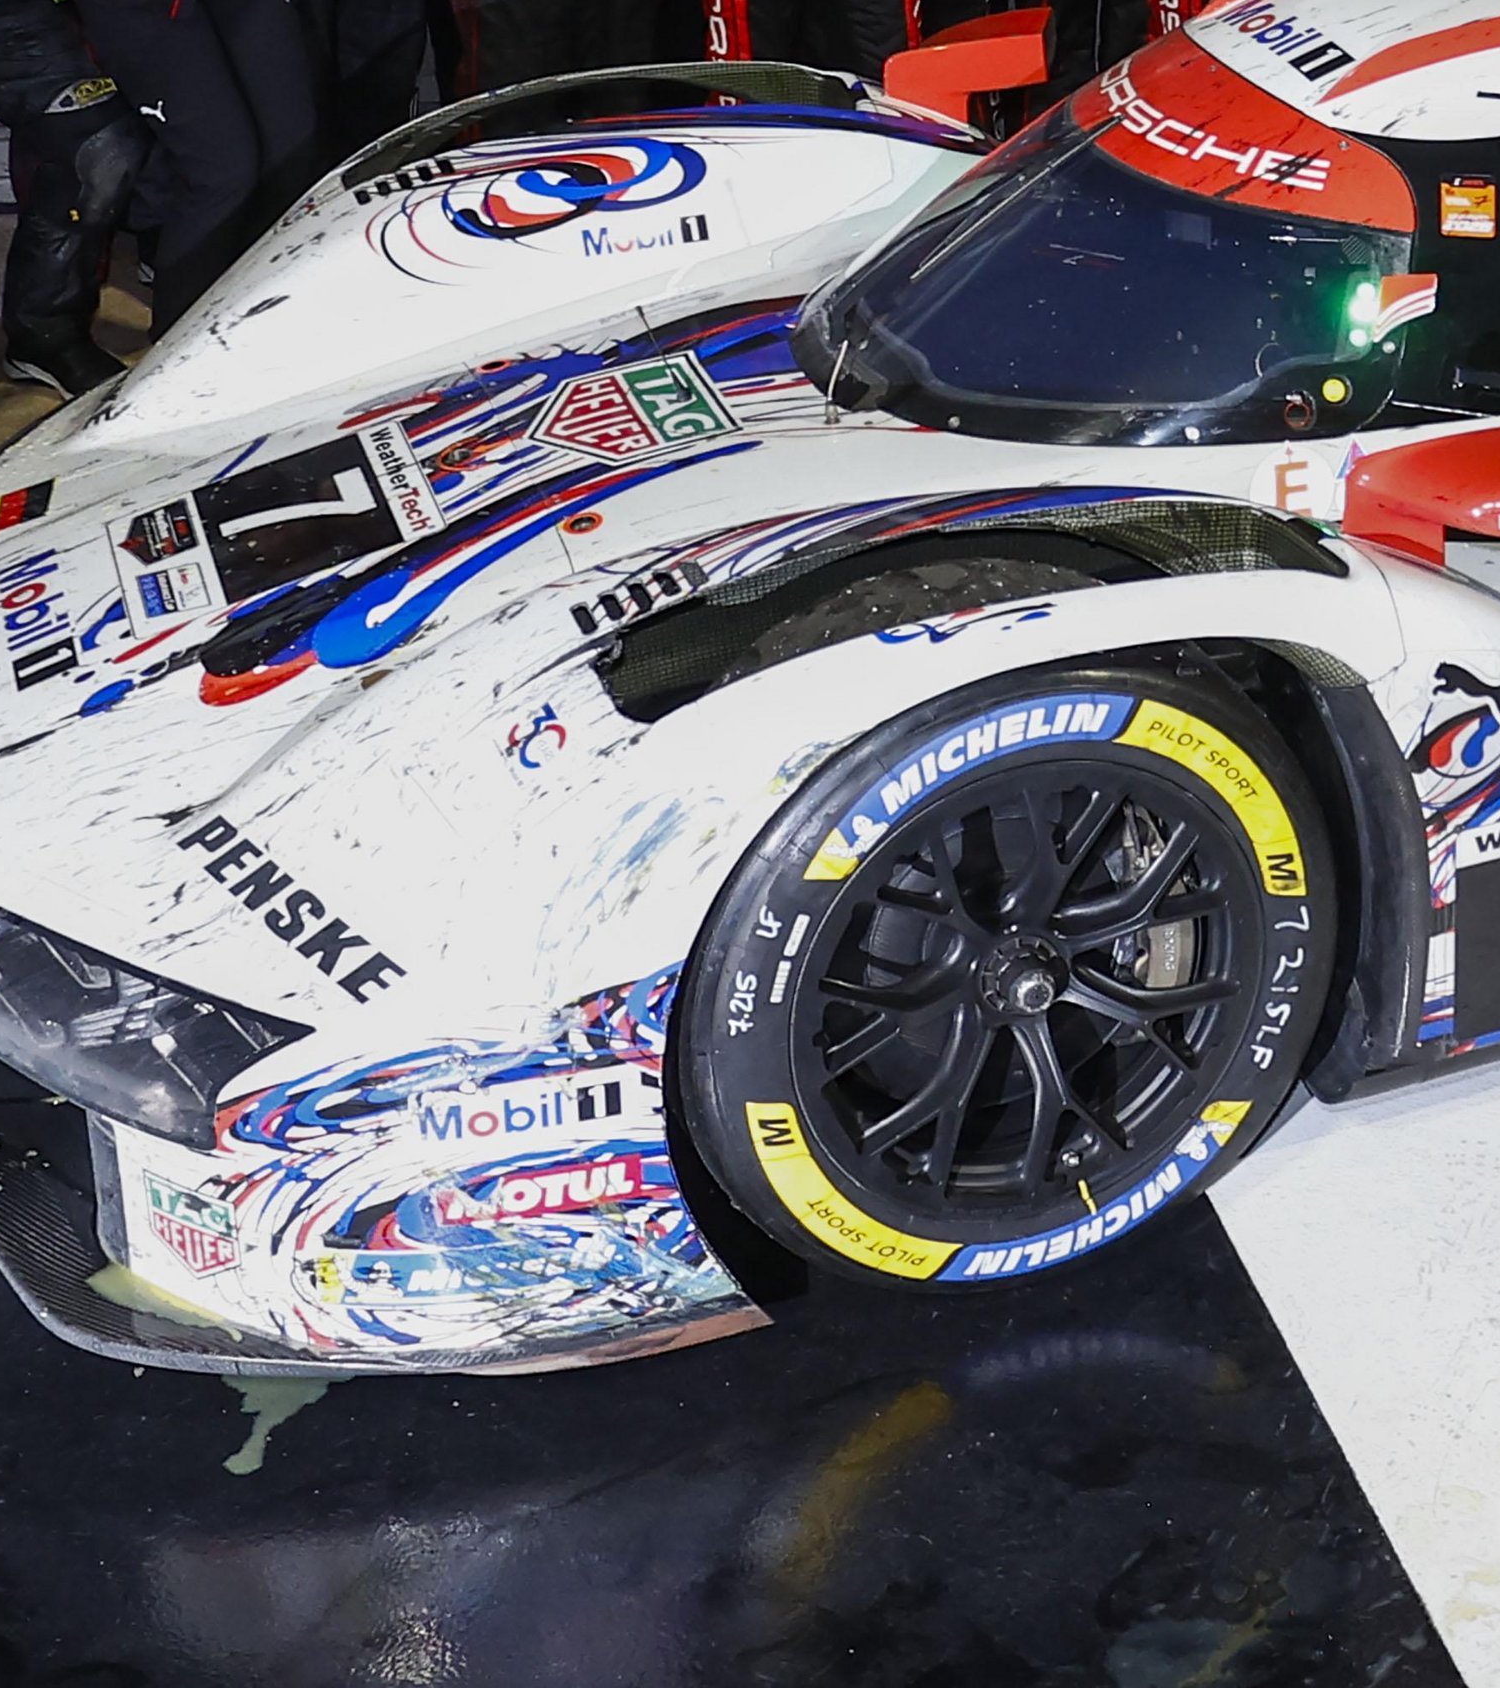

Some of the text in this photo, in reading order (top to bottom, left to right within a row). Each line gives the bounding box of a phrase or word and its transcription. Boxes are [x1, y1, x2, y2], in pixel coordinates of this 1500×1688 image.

[1099, 57, 1332, 192] ORSCHE
[217, 466, 379, 538] 7
[1274, 459, 1312, 512] E
[879, 701, 1111, 814] MICHELIN
[1147, 718, 1261, 802] PILOT SPORT
[1265, 852, 1298, 886] M
[178, 814, 408, 1005] PENSKE
[419, 1090, 565, 1142] Mobil
[805, 1195, 927, 1269] PILOT SPORT
[963, 1159, 1183, 1278] MICHELIN
